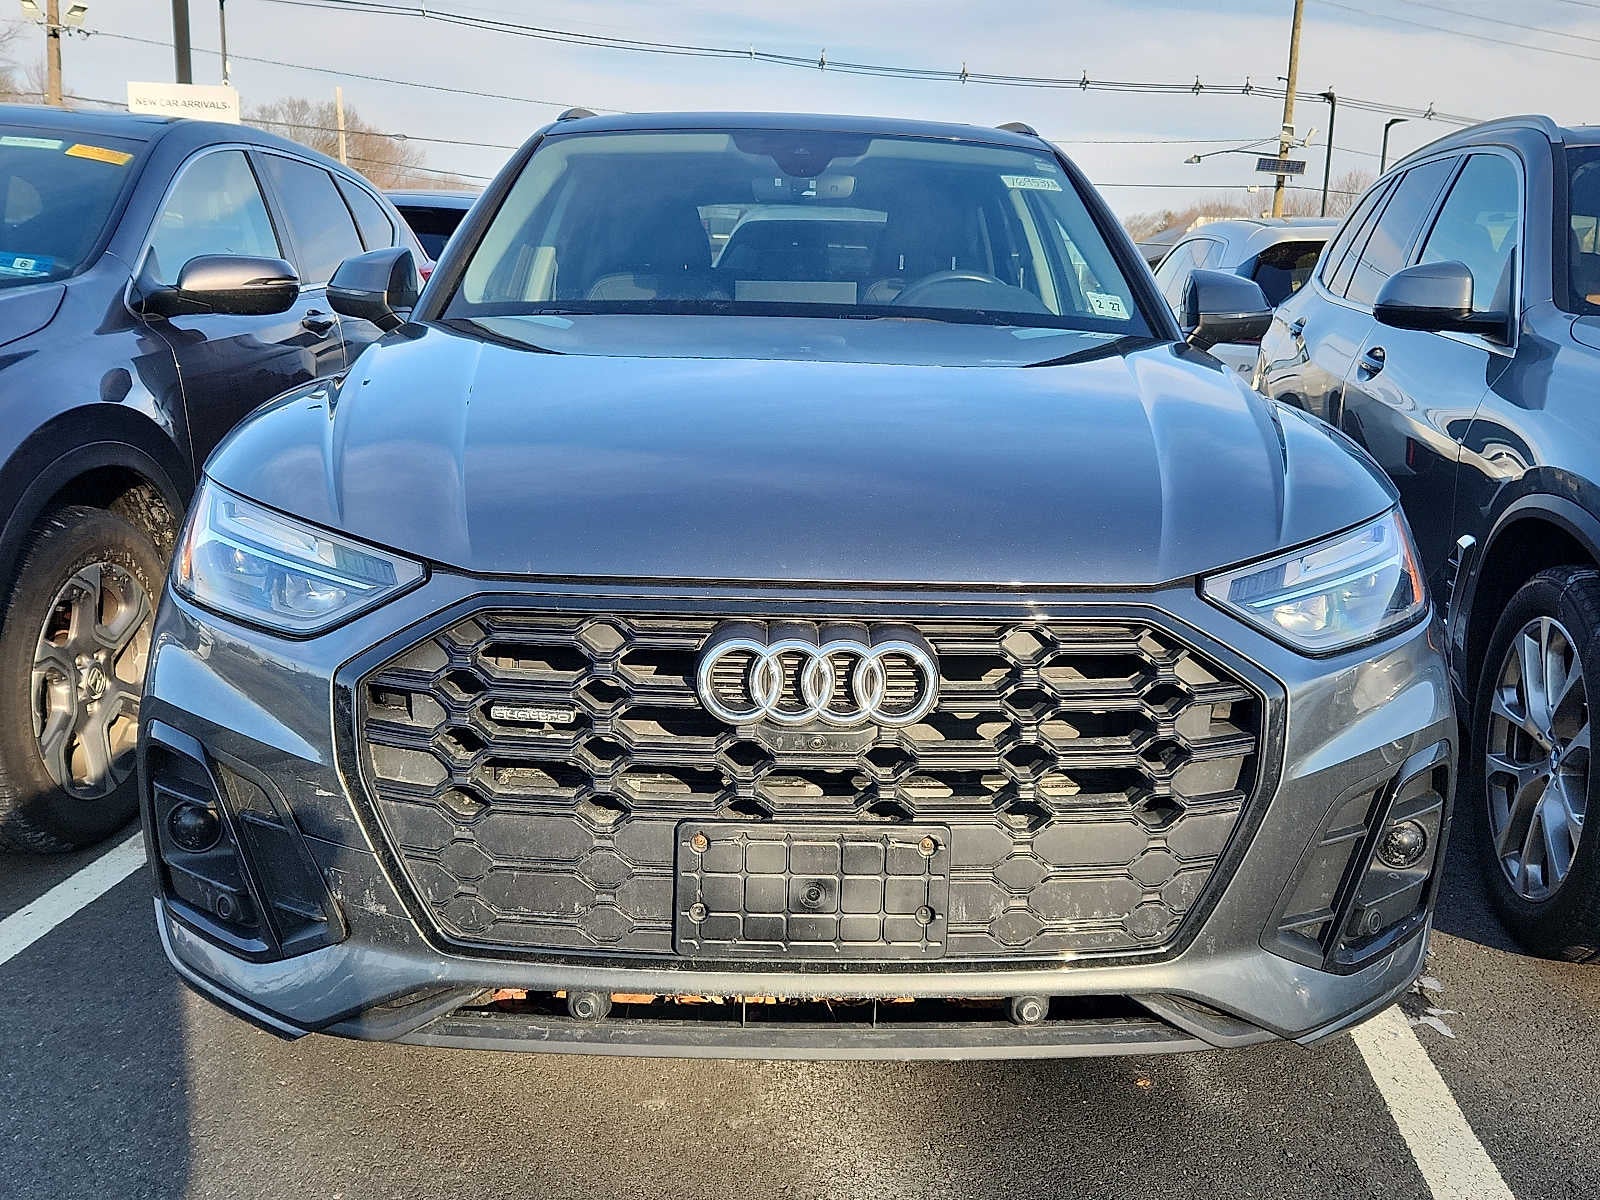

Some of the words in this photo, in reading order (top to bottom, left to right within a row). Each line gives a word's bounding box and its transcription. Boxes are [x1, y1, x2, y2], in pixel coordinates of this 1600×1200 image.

[135, 97, 157, 106] NEW
[160, 99, 179, 107] CAR
[180, 100, 228, 110] ARRIVALS
[1096, 299, 1104, 309] 2
[1109, 301, 1121, 311] 27
[493, 708, 571, 722] quattro
